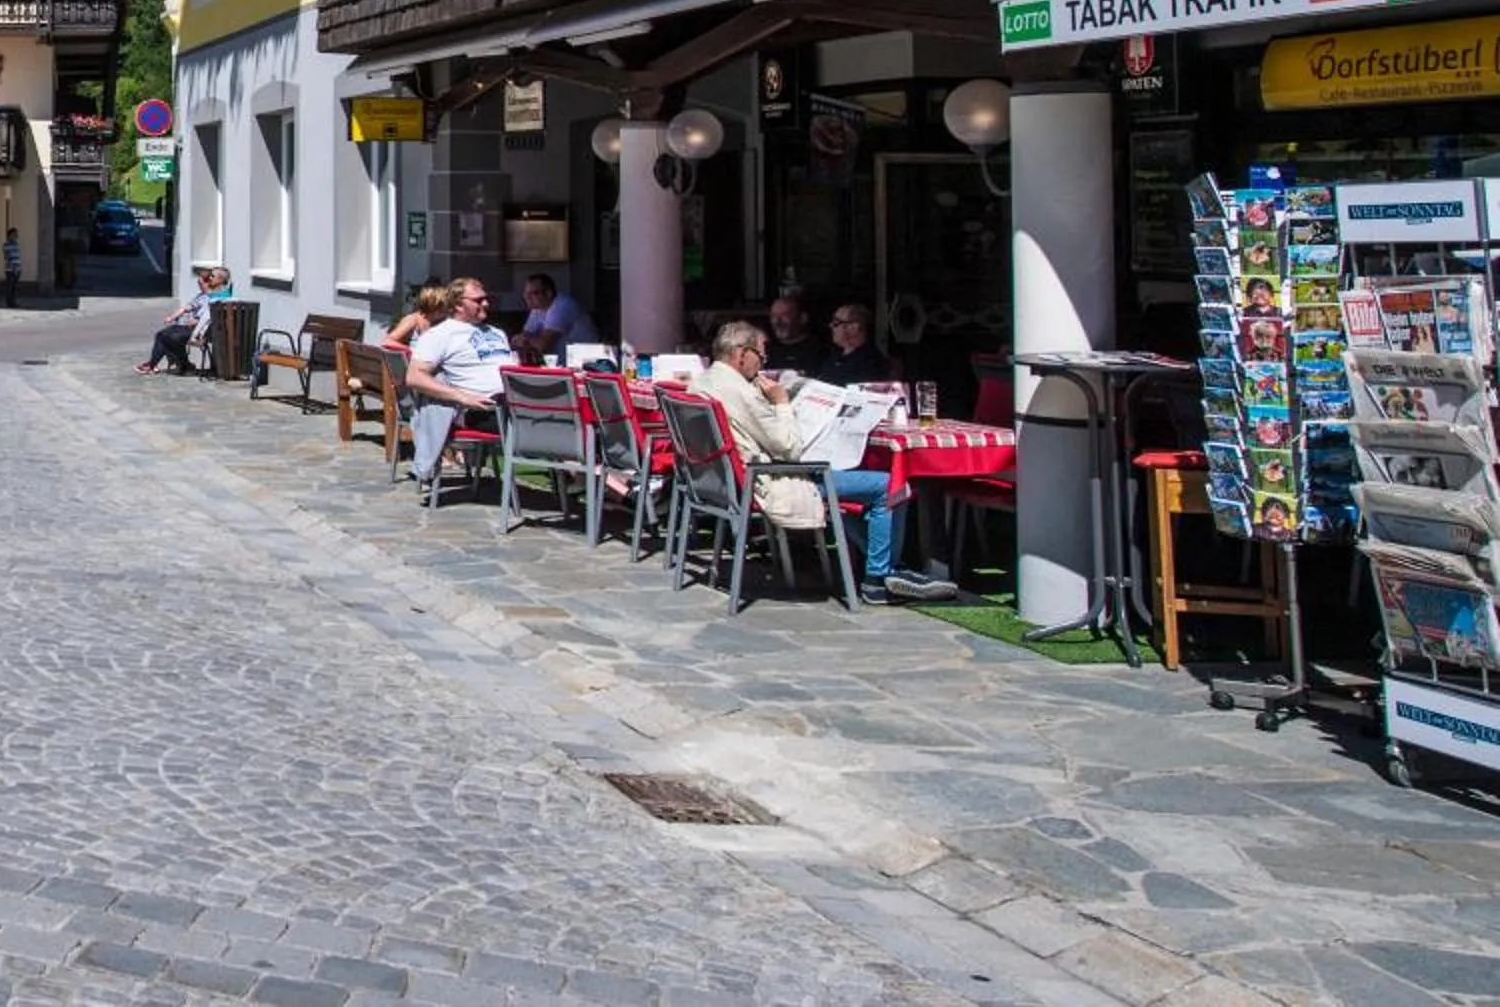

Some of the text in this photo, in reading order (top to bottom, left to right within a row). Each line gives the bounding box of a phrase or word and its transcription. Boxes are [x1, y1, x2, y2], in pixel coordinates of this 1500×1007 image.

[1005, 10, 1049, 33] LOTTO
[1310, 38, 1484, 80] Dorfstüberl
[1351, 205, 1386, 218] WELT
[1398, 202, 1461, 217] SONNTAG
[1400, 704, 1431, 723] WELT
